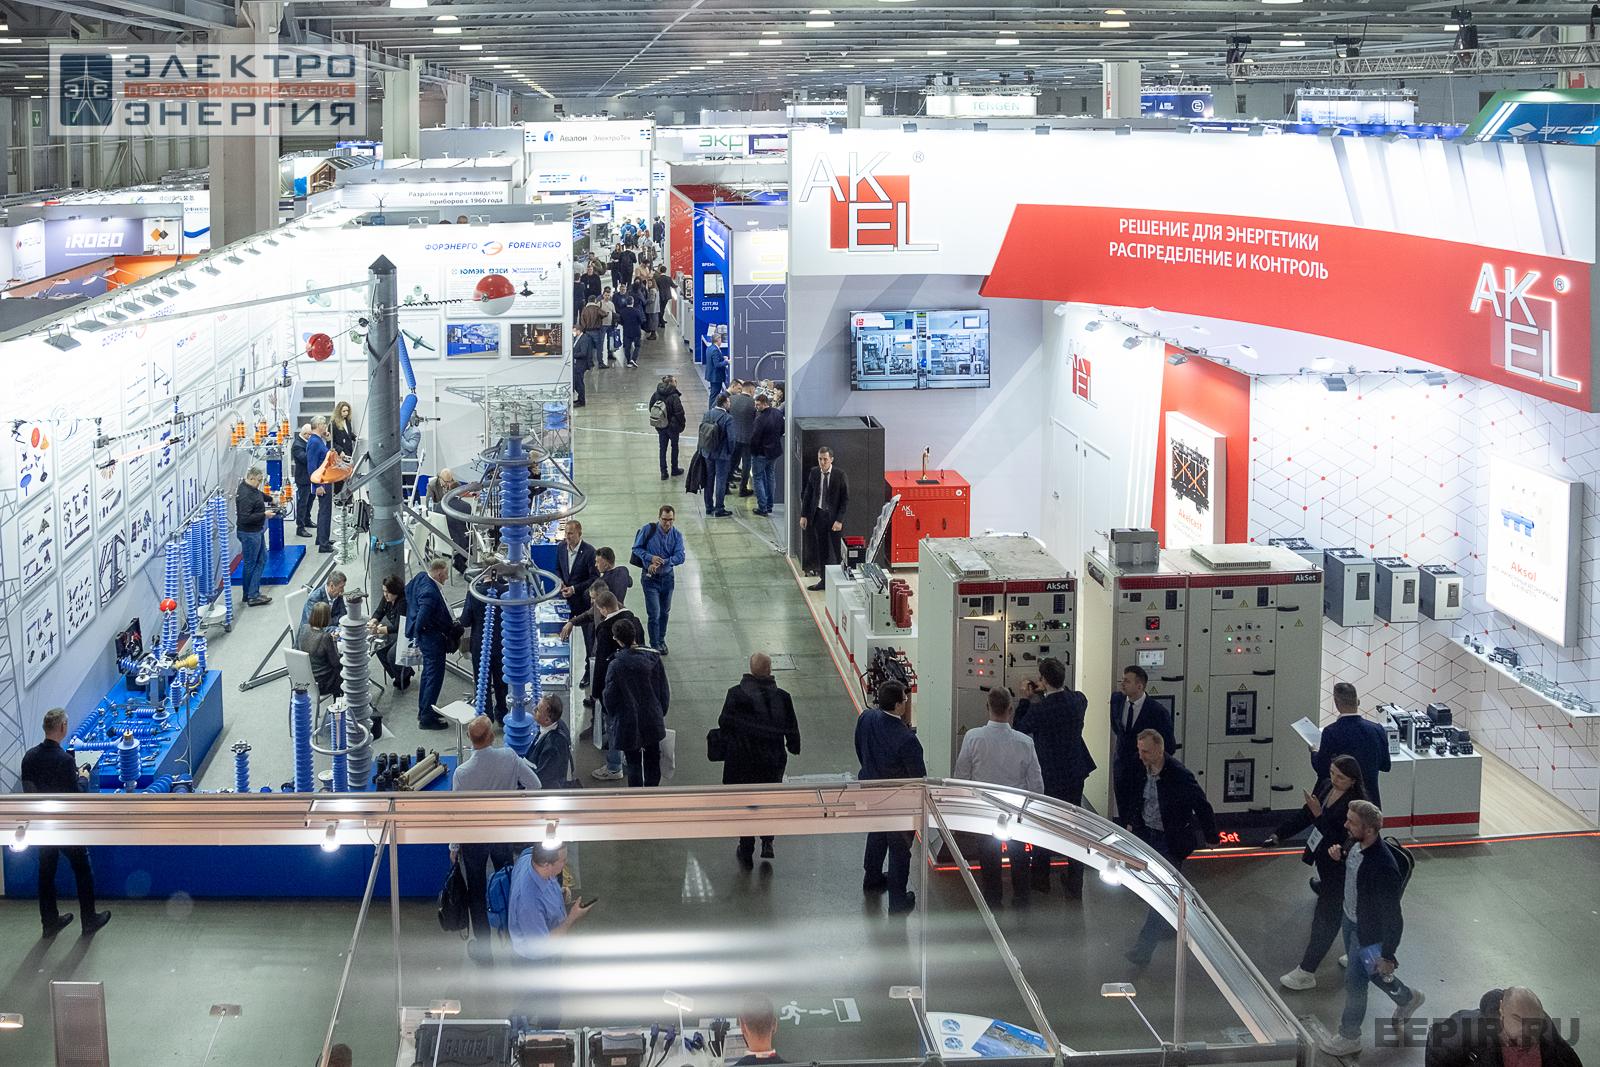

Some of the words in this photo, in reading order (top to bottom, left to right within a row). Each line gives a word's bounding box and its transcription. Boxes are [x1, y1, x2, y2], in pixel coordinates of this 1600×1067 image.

[972, 101, 1020, 111] TENGEN
[559, 133, 588, 142] Авалон
[409, 190, 448, 198] Разработка
[454, 190, 504, 198] производство
[1119, 218, 1190, 238] РЕШЕНИЕ
[1192, 223, 1224, 242] ДЛЯ
[1226, 226, 1319, 252] ЭНЕРГЕТИКИ
[65, 232, 125, 249] iROBO
[508, 241, 562, 249] FORENERGO
[424, 243, 478, 251] ФОРЭНЕРГО
[1109, 241, 1233, 268] РАСПРЕДЕЛЕНИЕ
[1235, 253, 1247, 269] И
[1250, 254, 1329, 280] КОНТРОЛЬ
[1511, 561, 1537, 582] Aksol
[1295, 574, 1317, 583] AkSet
[1046, 582, 1069, 591] AkSet
